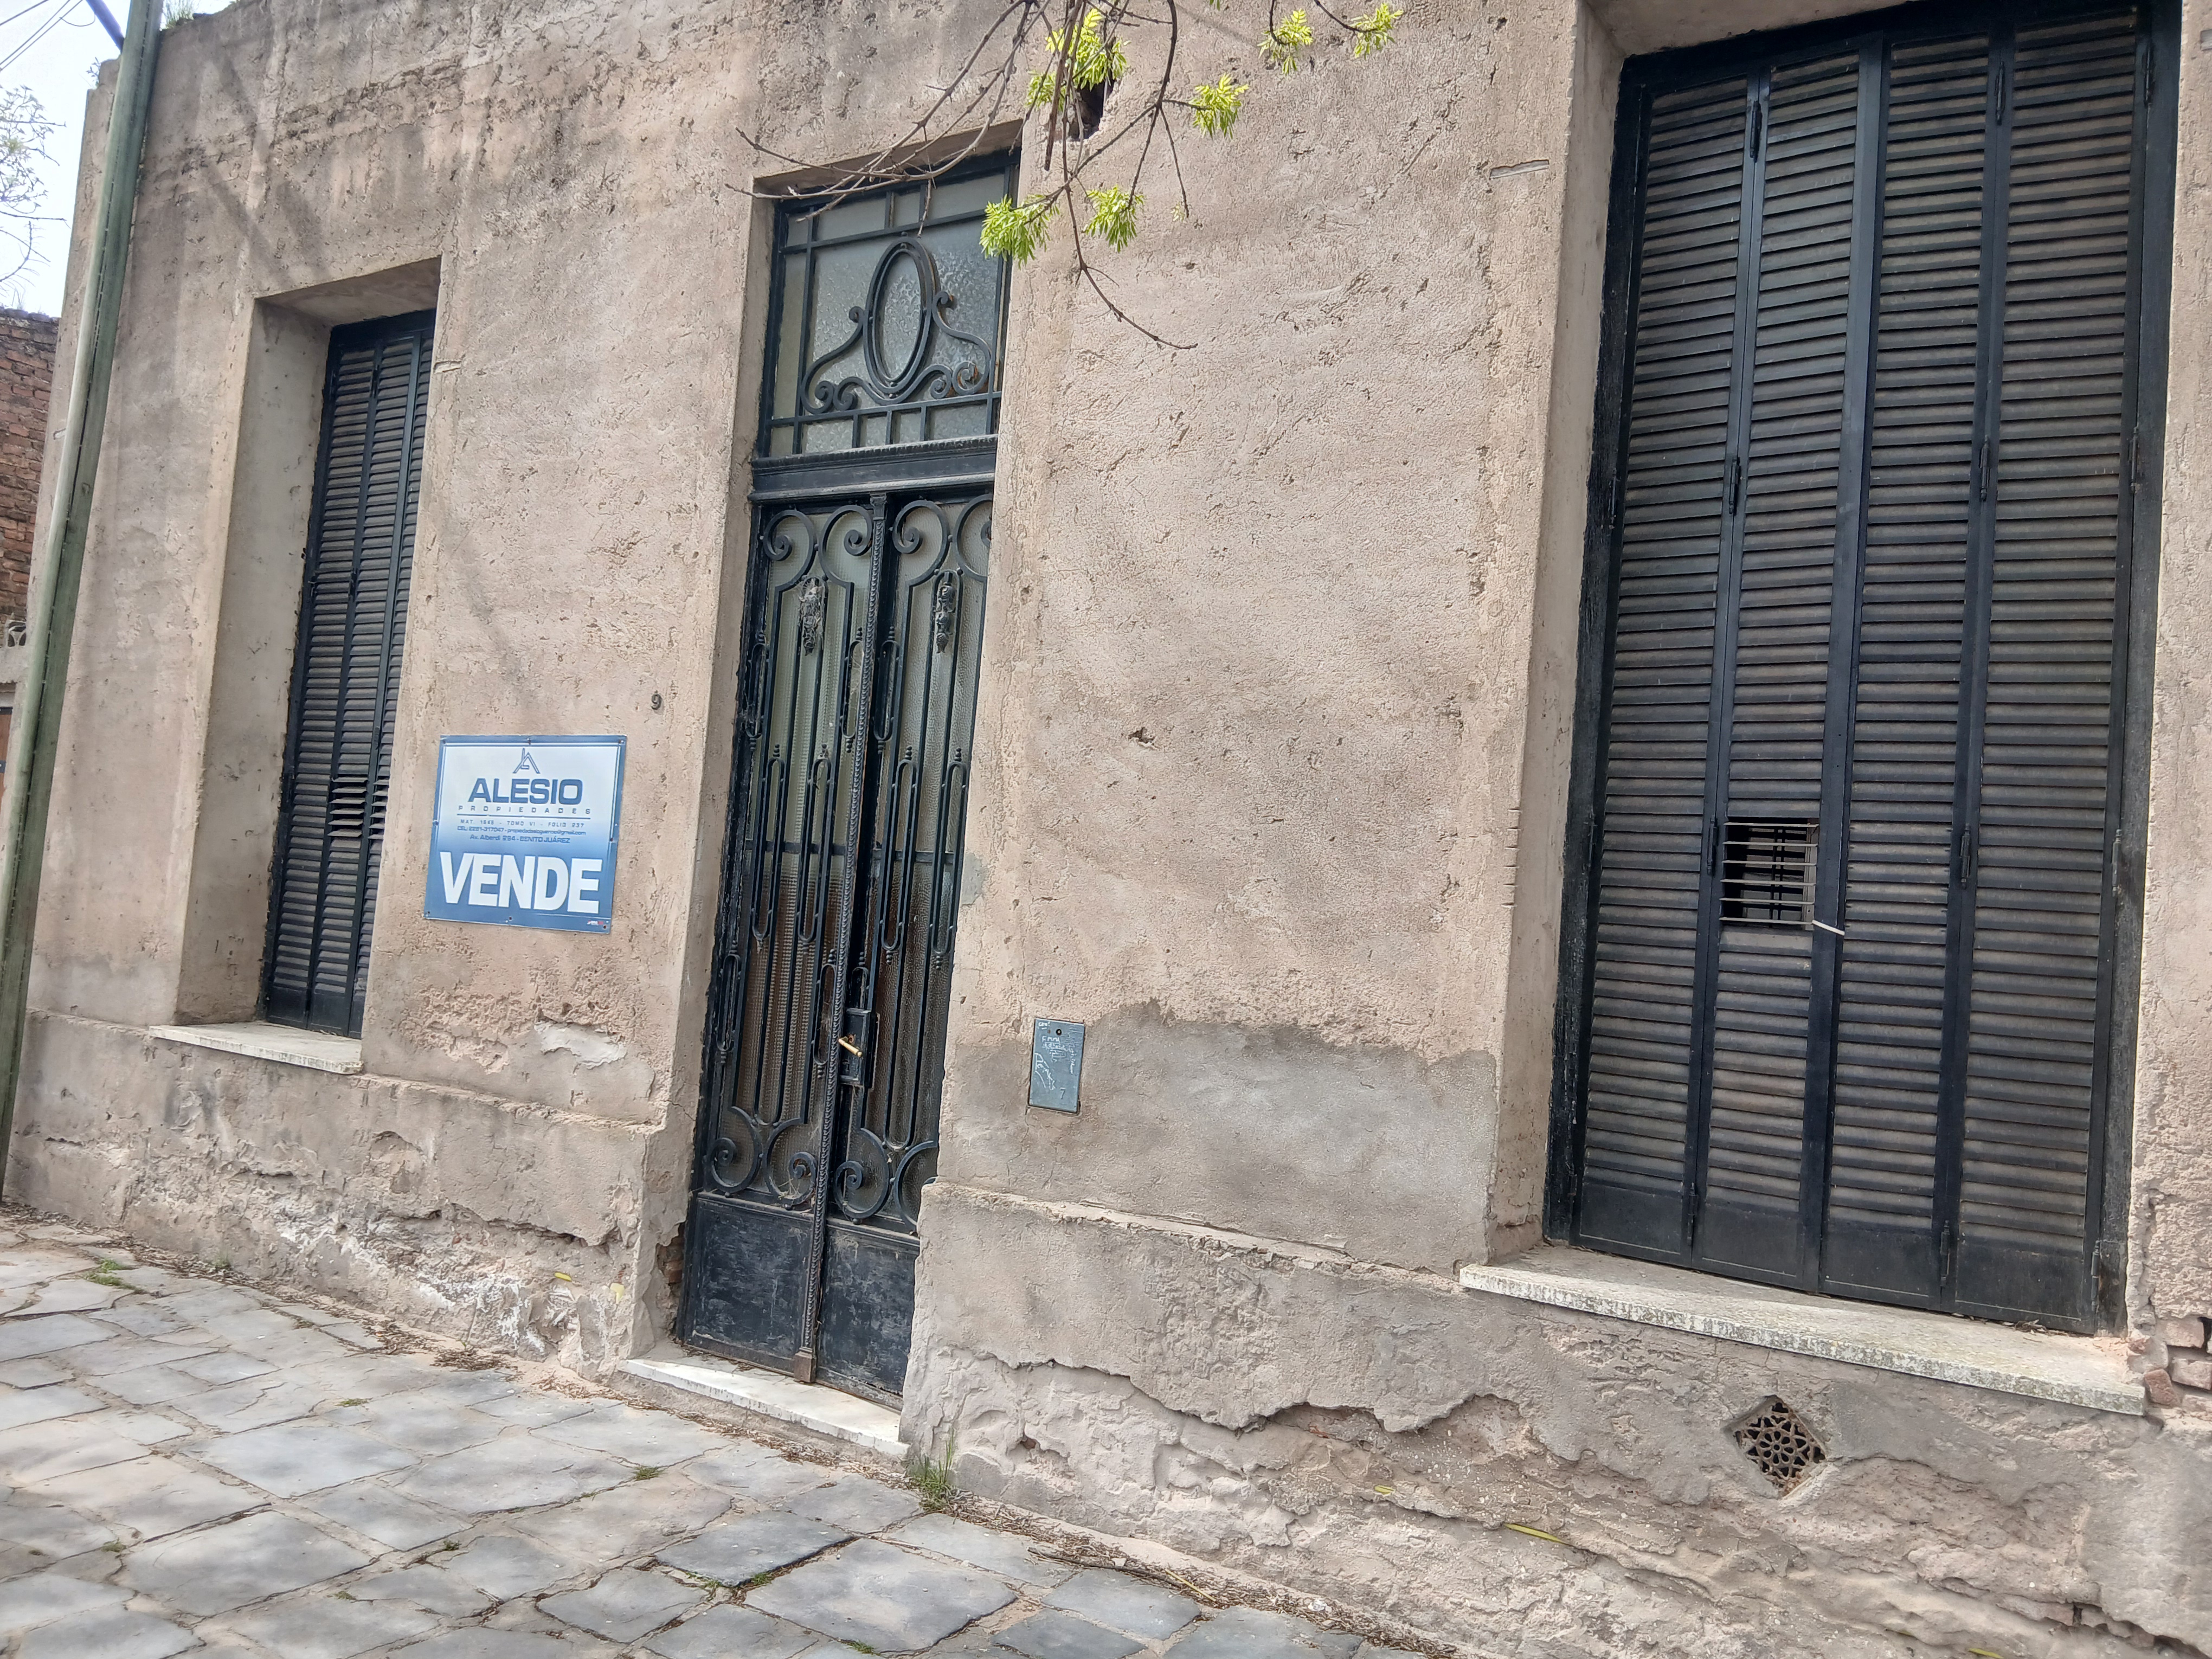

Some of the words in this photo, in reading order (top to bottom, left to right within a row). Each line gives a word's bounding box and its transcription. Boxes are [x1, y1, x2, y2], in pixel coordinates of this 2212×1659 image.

[467, 778, 583, 805] ALESIO
[458, 805, 591, 815] PROPIEDADES
[440, 851, 603, 914] VENDE
